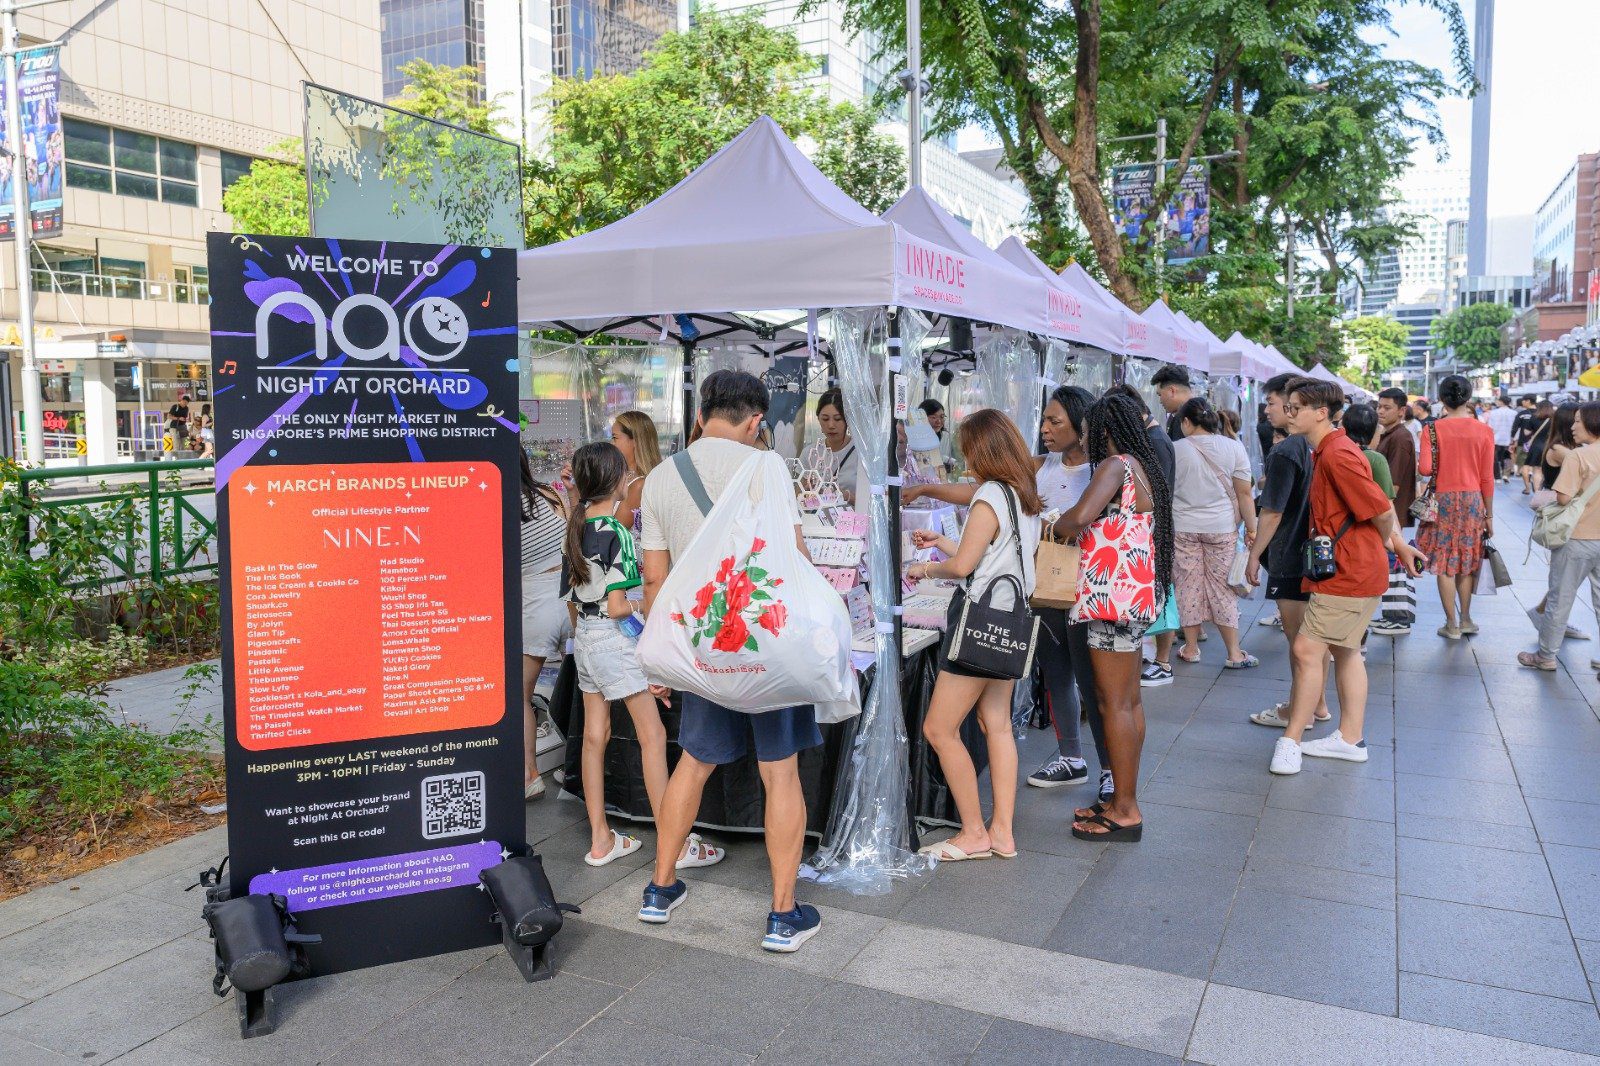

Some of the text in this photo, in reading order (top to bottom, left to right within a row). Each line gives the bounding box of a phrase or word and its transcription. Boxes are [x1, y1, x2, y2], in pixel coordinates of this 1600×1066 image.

[1118, 170, 1150, 180] T100
[286, 254, 438, 276] WELCOME TO
[907, 244, 964, 288] INVADE
[257, 376, 470, 394] NIGHT AT ORCHARD
[274, 414, 456, 424] THE ONLY NIGHT MARKET IN
[232, 427, 496, 439] SINGAPORE'S PRIME SHOPPING DISTRICT
[268, 476, 469, 492] MARCH BRANDS LINEUP
[312, 508, 348, 517] Official
[351, 506, 393, 516] Lifestyle
[324, 526, 420, 548] NINE.N
[269, 592, 300, 600] Jewelry
[966, 628, 1026, 650] TOTE BAG
[987, 623, 1010, 637] THE
[407, 679, 453, 688] Compassion
[384, 700, 417, 708] Maximus
[269, 710, 304, 719] Timeless
[251, 728, 311, 740] Thrifted Clicks
[248, 737, 498, 773] Happening every LAST weekend of the month
[297, 756, 455, 782] 3PM 10PM Friday Sunday
[266, 791, 410, 817] Want to showcase your brand
[301, 813, 328, 825] Night
[331, 811, 343, 819] At
[346, 805, 390, 818] Orchard?
[294, 827, 385, 846] Scan this QR code!
[303, 854, 454, 883] For more information about NAO,
[288, 884, 316, 896] follow
[333, 871, 409, 889] @nightatorchard
[426, 861, 469, 875] Instagram
[320, 891, 347, 902] check
[386, 880, 420, 891] website
[424, 876, 452, 887] nao.sg
